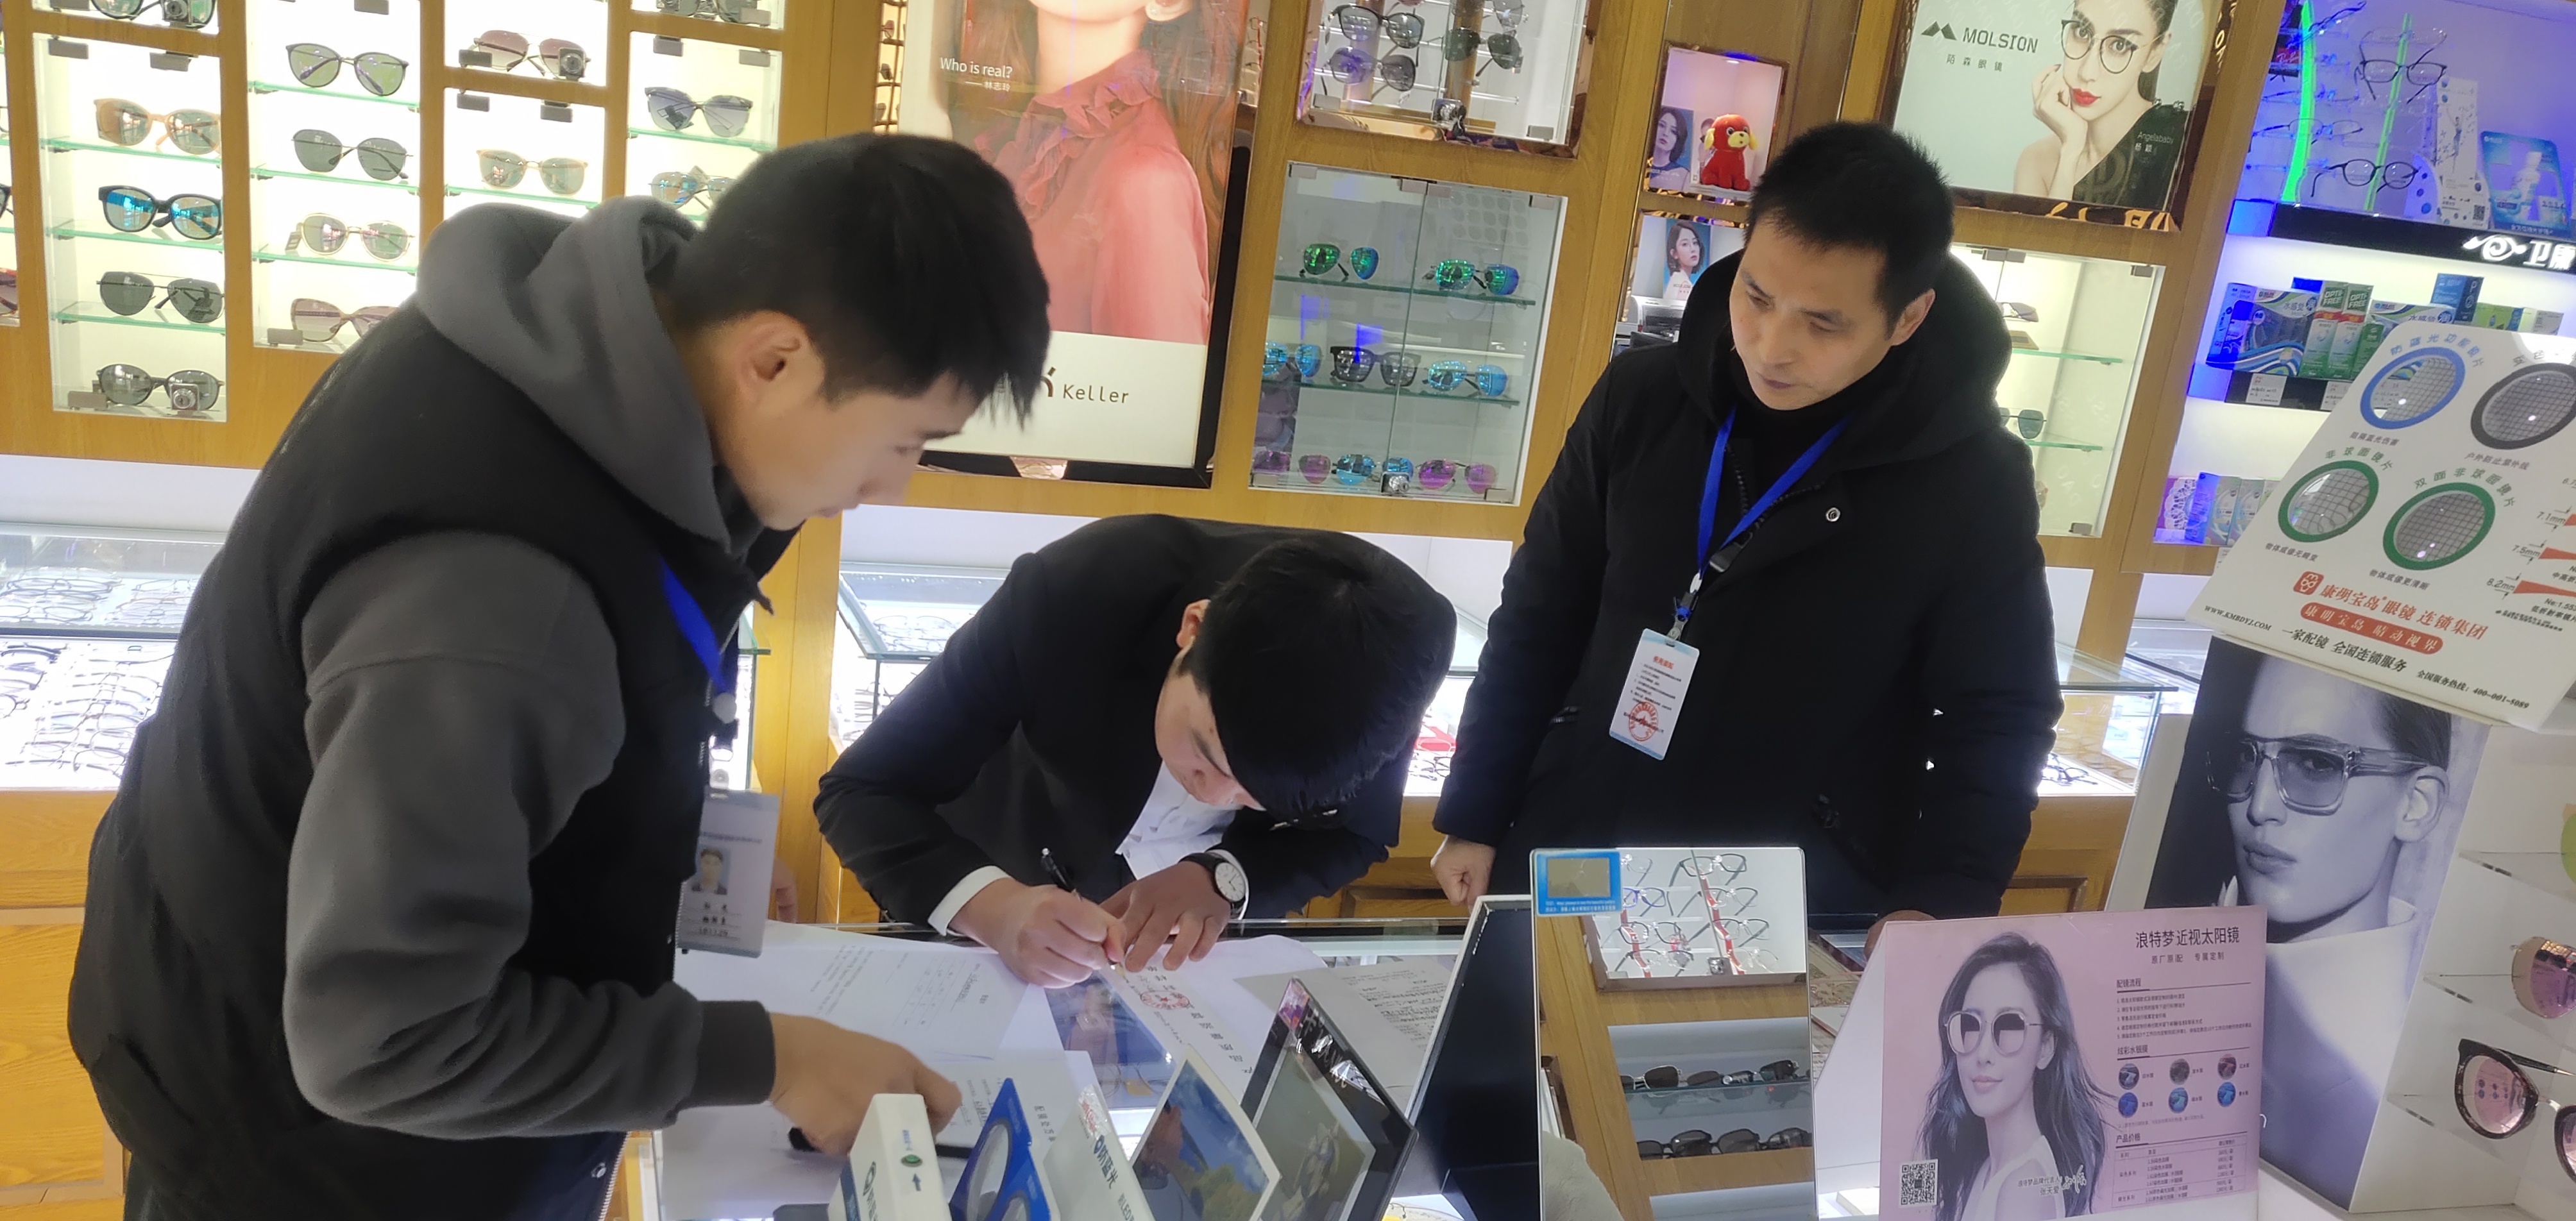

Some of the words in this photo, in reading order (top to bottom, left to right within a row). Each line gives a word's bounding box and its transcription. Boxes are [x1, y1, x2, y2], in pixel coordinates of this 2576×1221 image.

[1963, 27, 2038, 53] MOLSION
[940, 56, 967, 72] Who
[970, 61, 979, 74] is
[983, 65, 1013, 78] real?
[2137, 131, 2174, 145] Angelababy
[1063, 383, 1129, 403] Keller
[2324, 446, 2393, 471] 非球面镜片
[2536, 511, 2566, 525] 7.1mm
[2512, 544, 2541, 557] 7.5mm
[2486, 578, 2516, 591] 8.2mm
[2282, 628, 2330, 650] 一家配镜
[2330, 641, 2407, 673] 全国连锁服务
[2135, 927, 2240, 948] 浪特梦近视太阳镜
[2151, 954, 2183, 964] 原厂原配
[2194, 952, 2224, 961] 专属定制
[2117, 978, 2142, 988] 配镜流程
[2116, 1133, 2141, 1144] 产品价格
[1097, 1143, 1118, 1190] 防蓝光
